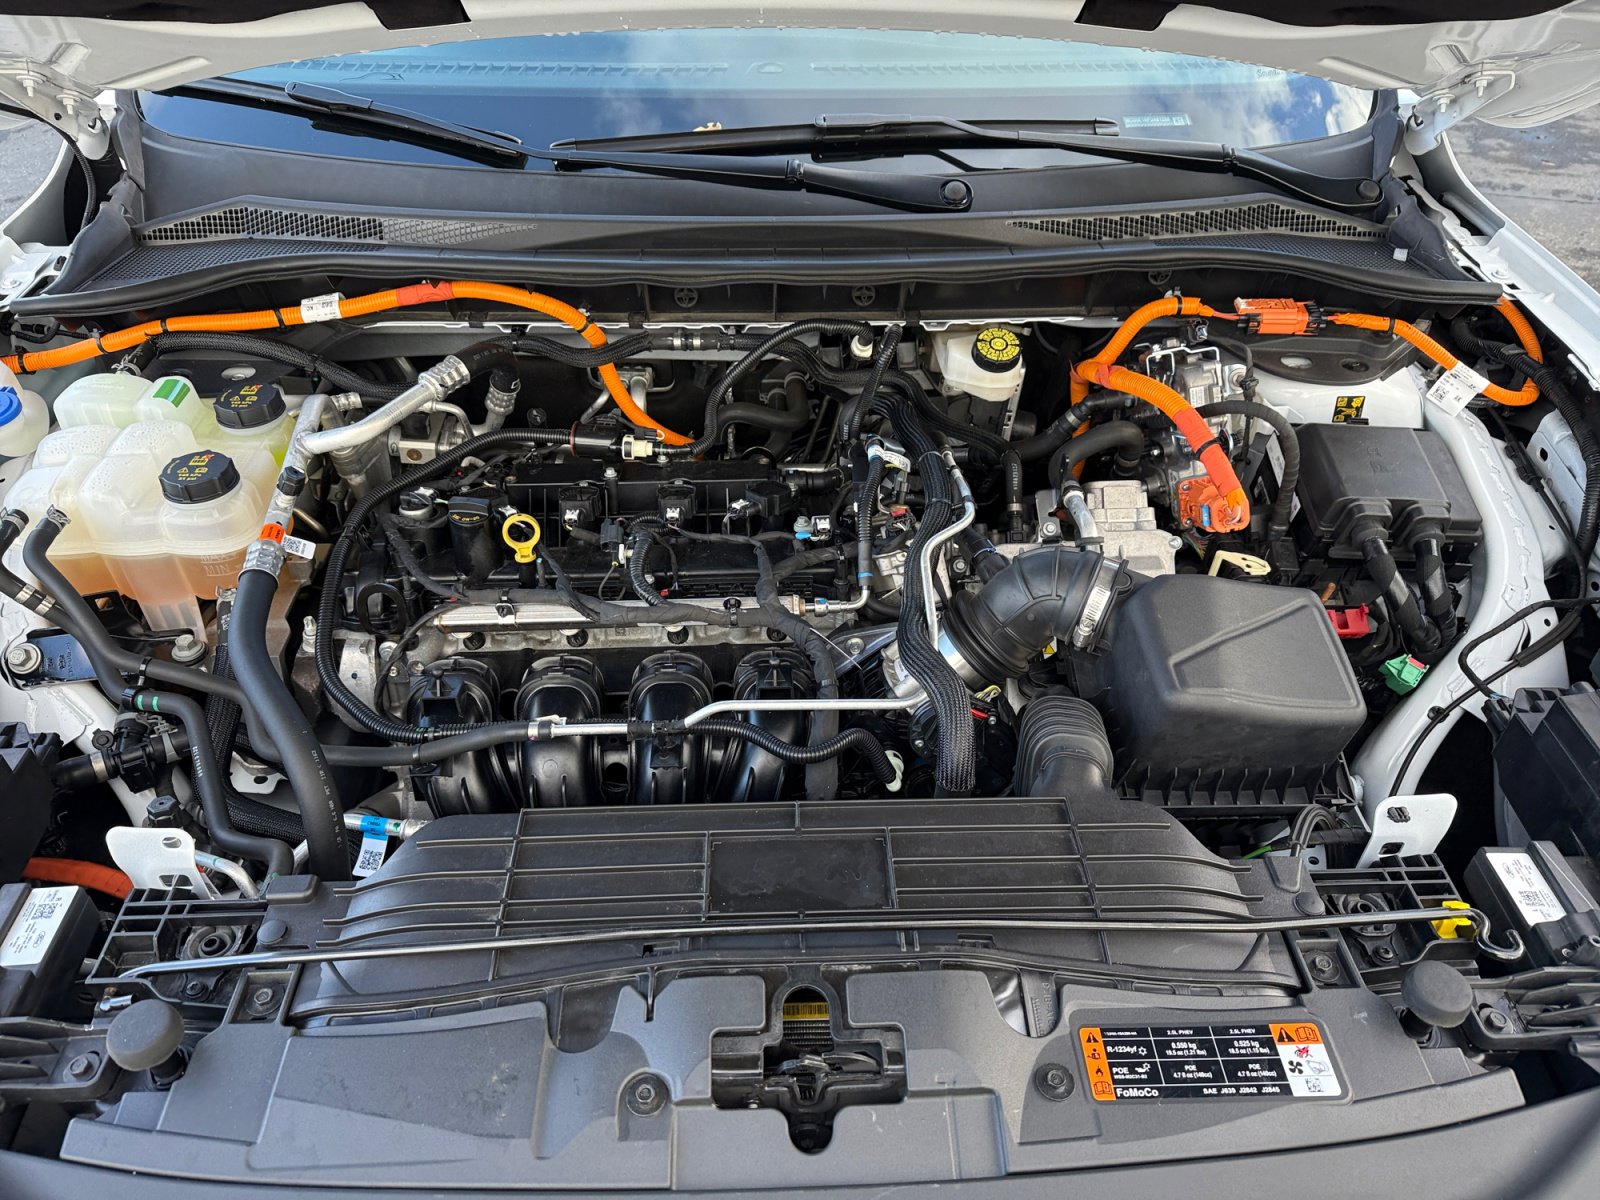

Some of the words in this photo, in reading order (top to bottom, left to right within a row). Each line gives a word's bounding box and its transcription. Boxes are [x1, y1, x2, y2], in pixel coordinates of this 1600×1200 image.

[1188, 1042, 1197, 1050] kg
[1251, 1040, 1260, 1048] kg
[1107, 1046, 1137, 1054] R-1234yf
[1116, 1088, 1159, 1097] FoMoCo
